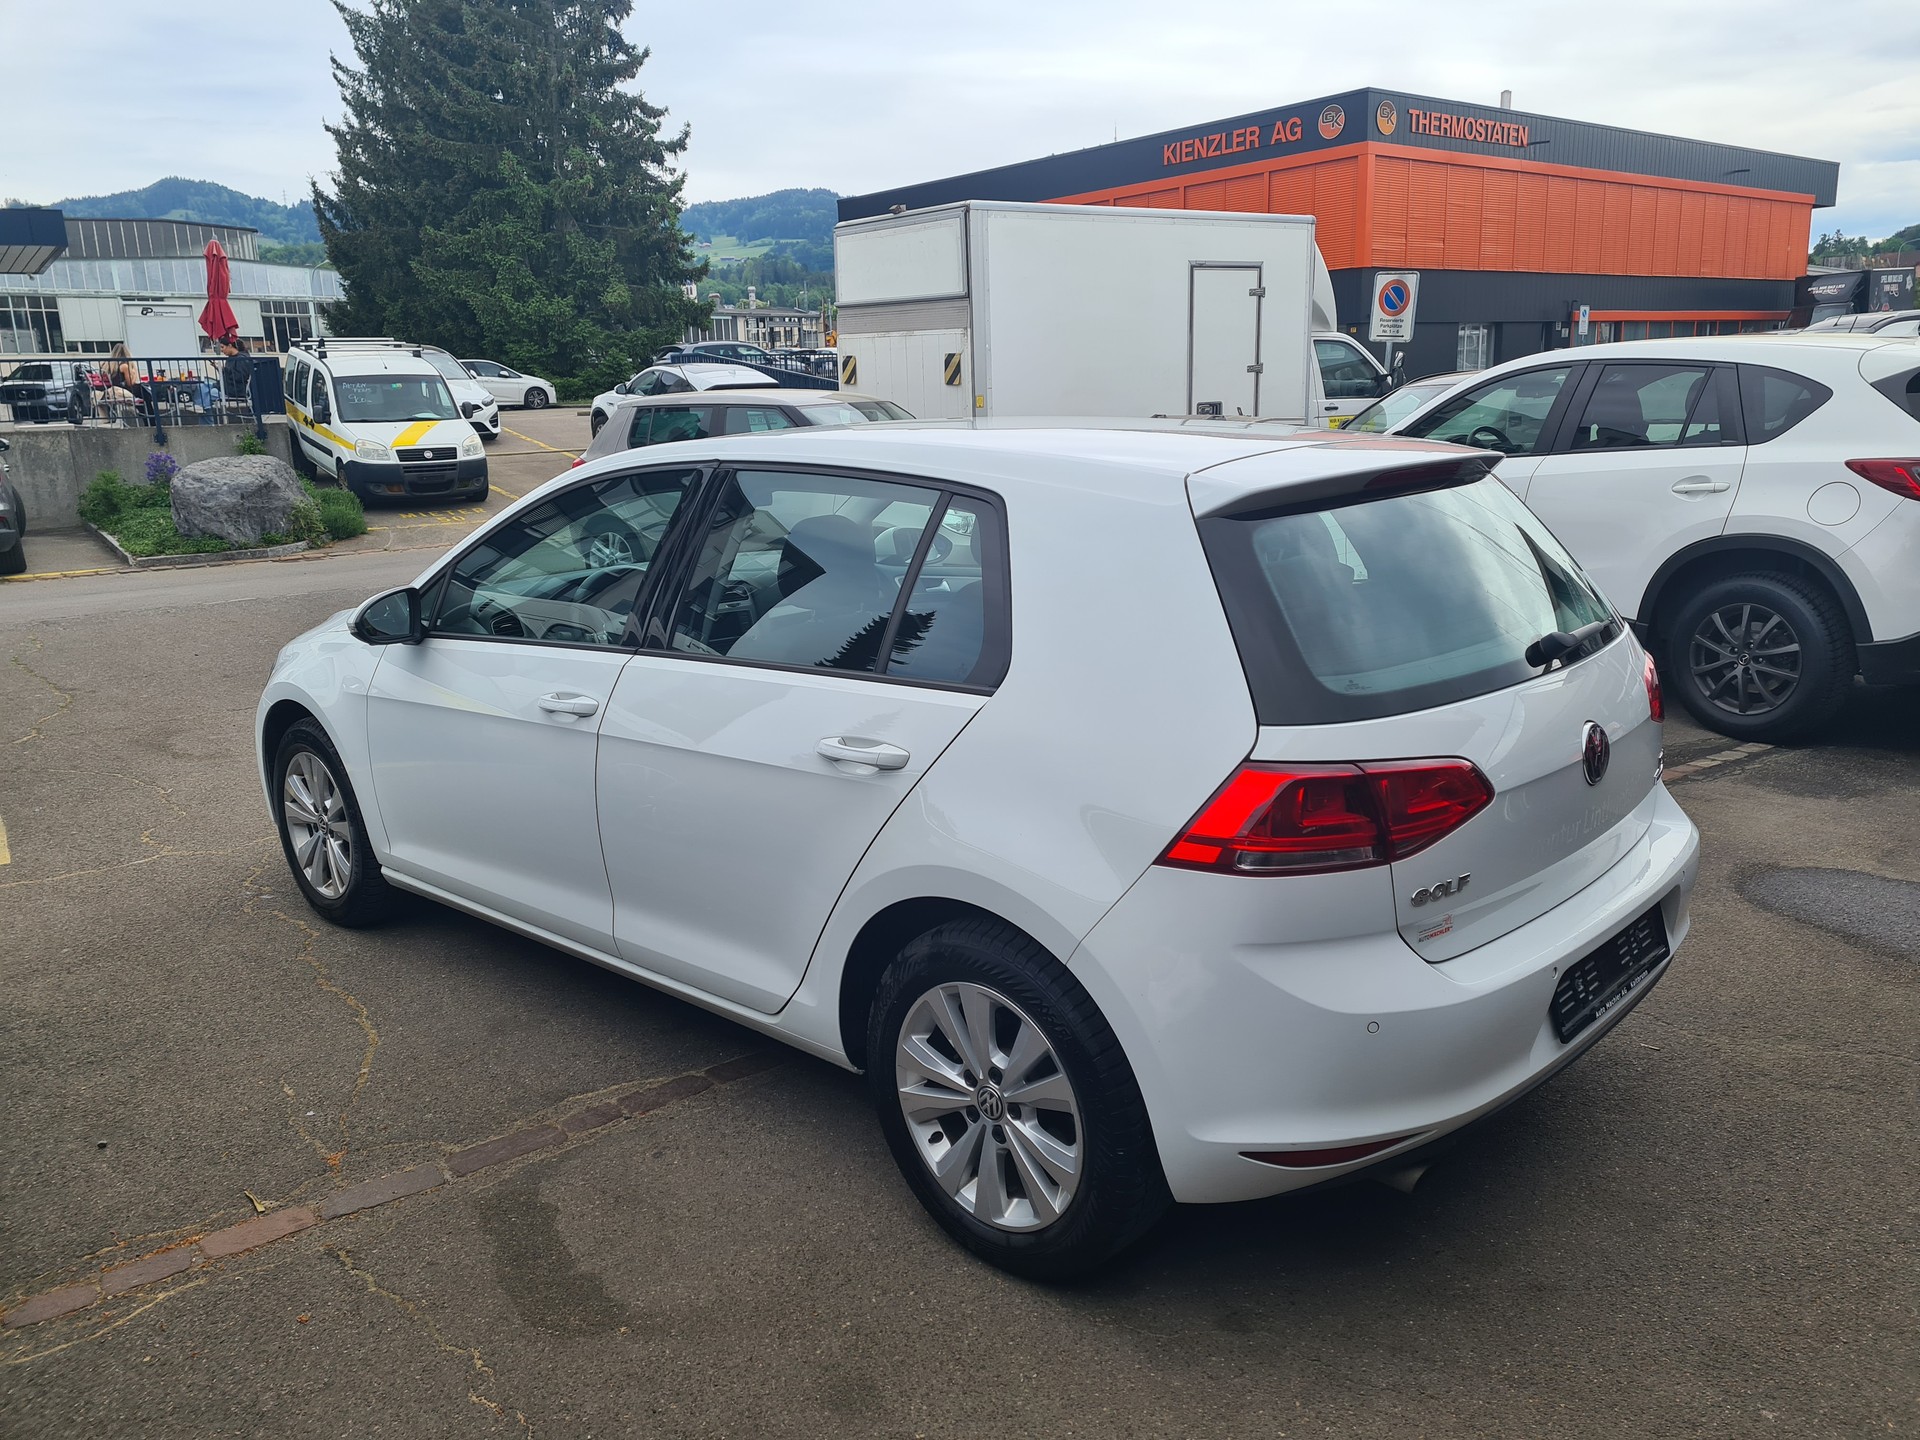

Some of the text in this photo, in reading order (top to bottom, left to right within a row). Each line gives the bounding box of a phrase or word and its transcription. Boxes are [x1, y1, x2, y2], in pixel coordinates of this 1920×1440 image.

[1163, 117, 1303, 166] KIENZLER AG
[1408, 109, 1529, 147] THERMOSTATEN
[1410, 872, 1470, 907] GOLF
[1621, 986, 1628, 997] AG
